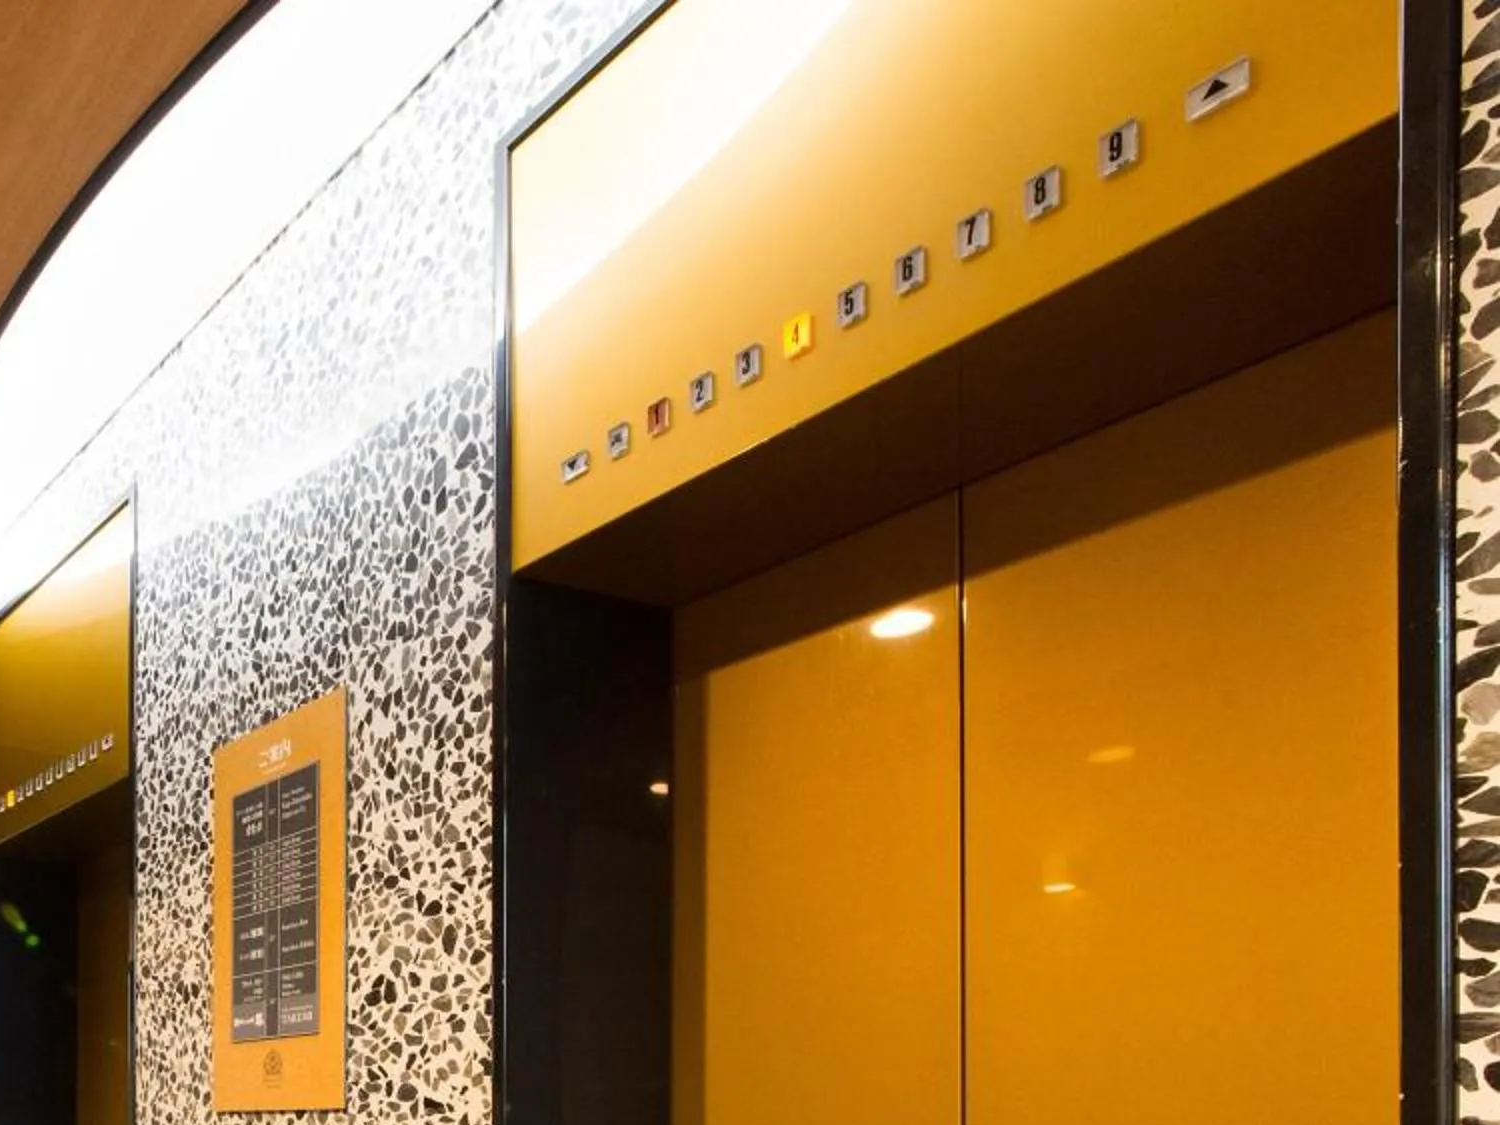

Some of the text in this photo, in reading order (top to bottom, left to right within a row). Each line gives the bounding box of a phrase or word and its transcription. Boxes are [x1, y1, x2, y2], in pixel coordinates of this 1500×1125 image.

[695, 379, 705, 403] 2
[739, 351, 751, 375] 3
[791, 320, 801, 346] 4
[843, 289, 856, 316] 5
[902, 255, 914, 282] 6
[965, 215, 977, 246] 7
[1034, 176, 1047, 205] 8
[1108, 131, 1123, 162] 9
